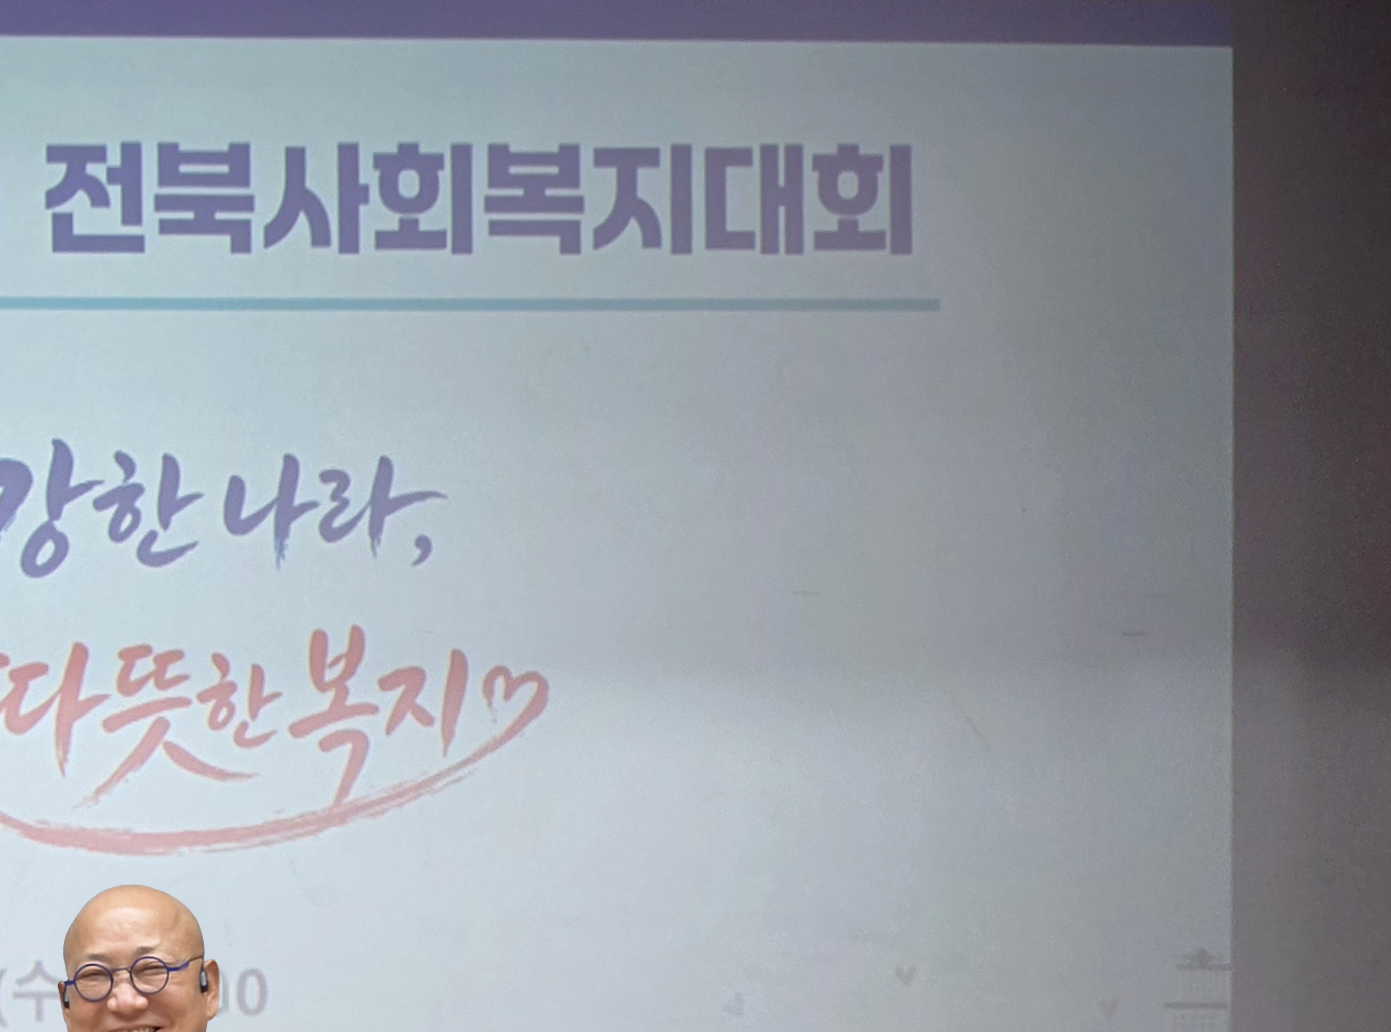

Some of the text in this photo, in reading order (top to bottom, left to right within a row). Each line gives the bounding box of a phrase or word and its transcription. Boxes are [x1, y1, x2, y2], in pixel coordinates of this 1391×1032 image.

[44, 141, 914, 256] 전북사회복지대회
[222, 452, 448, 572] 나라,
[288, 623, 471, 801] 복지
